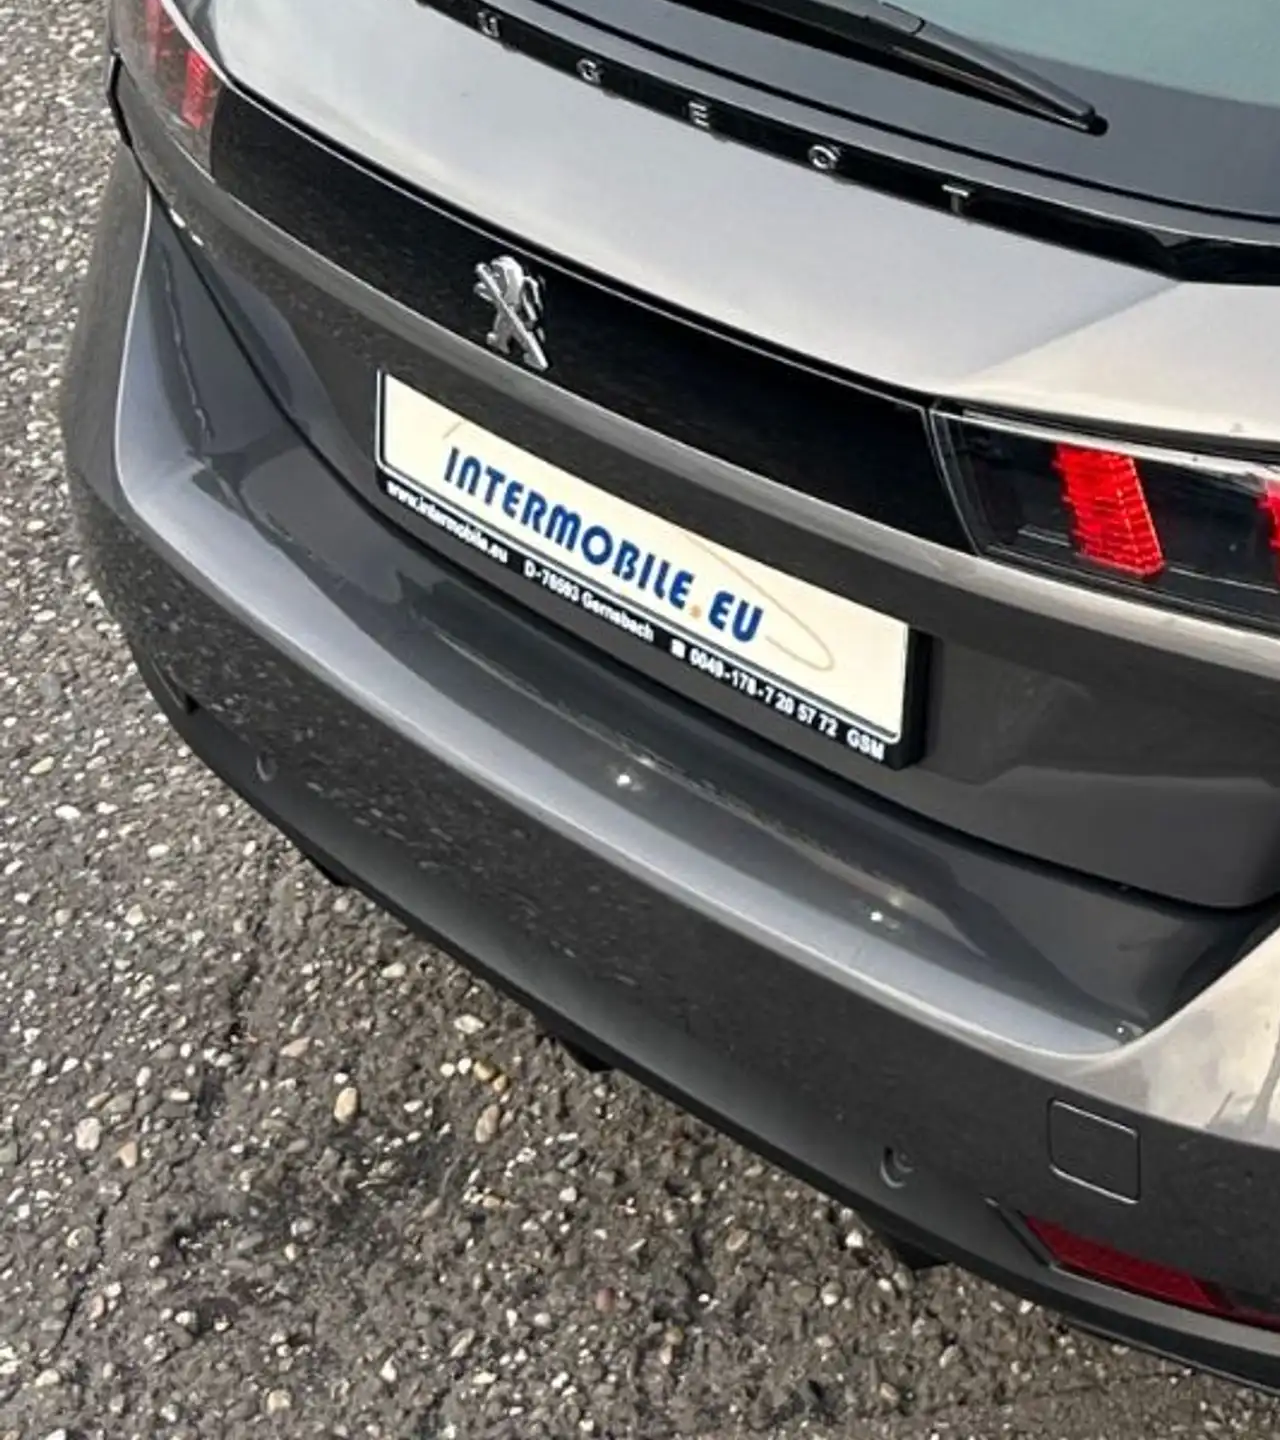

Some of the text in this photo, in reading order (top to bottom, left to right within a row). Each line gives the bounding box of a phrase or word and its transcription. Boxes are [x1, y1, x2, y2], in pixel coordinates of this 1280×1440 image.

[386, 480, 508, 564] www.intermobile.eu
[774, 692, 795, 716] 20
[797, 703, 816, 725] 57
[816, 713, 840, 738] 72
[846, 728, 886, 762] GSM
[443, 445, 765, 642] INTERMOBILE.EU
